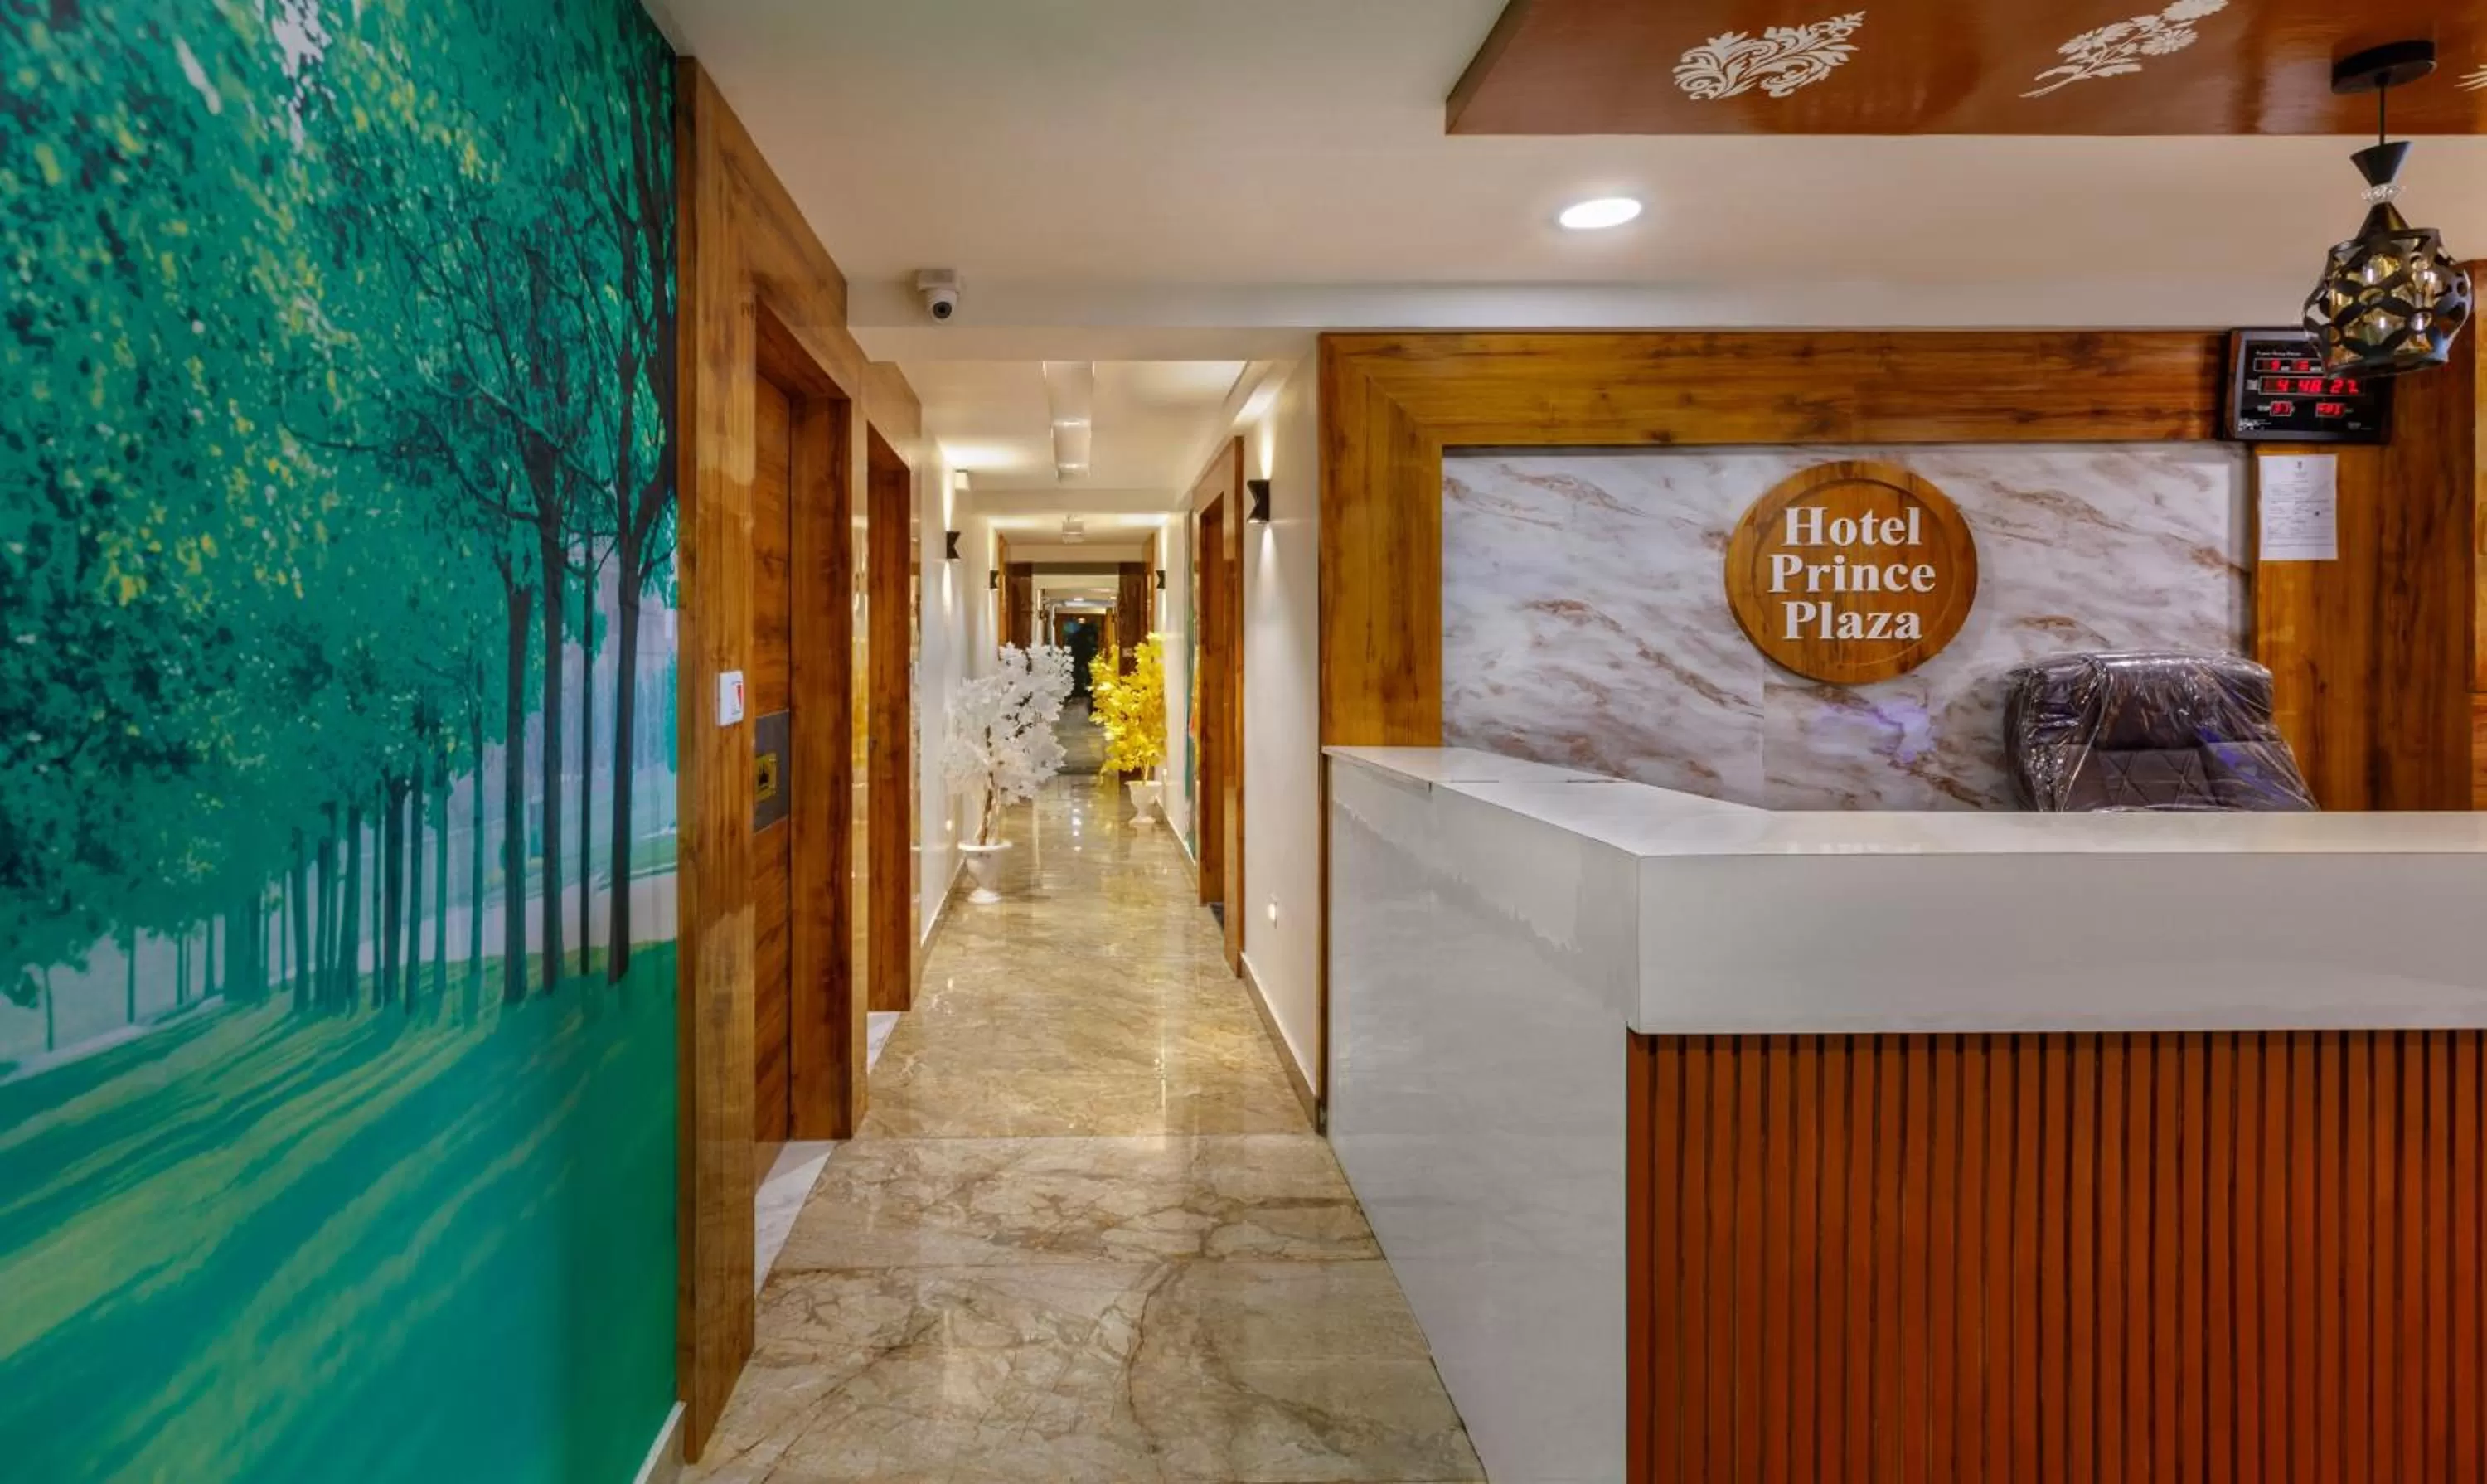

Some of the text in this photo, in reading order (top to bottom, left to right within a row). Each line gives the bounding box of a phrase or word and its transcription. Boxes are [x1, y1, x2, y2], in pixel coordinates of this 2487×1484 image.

[1782, 507, 1922, 546] Hotel
[1767, 554, 1937, 593] Prince
[1781, 600, 1923, 640] Plaza
